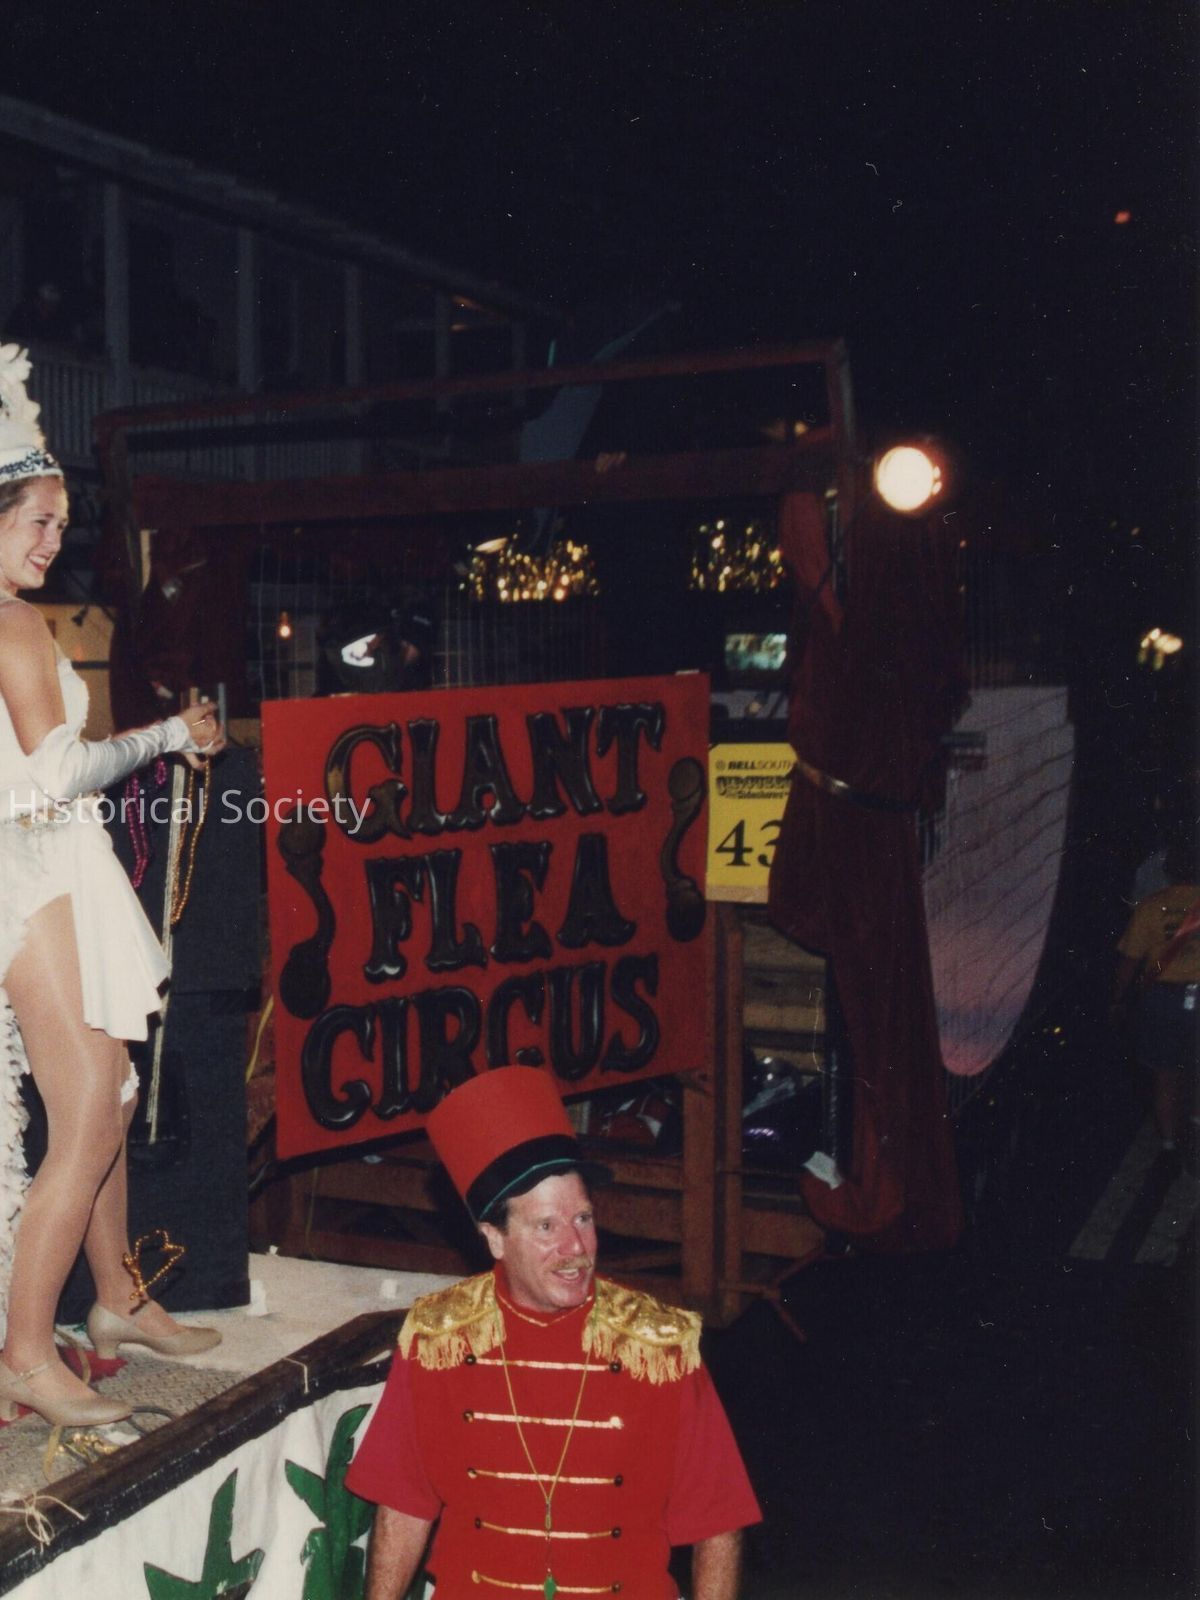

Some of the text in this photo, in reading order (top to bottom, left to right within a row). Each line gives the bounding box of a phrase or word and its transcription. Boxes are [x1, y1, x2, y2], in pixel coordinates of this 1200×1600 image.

[324, 703, 665, 843] GIANT
[364, 833, 637, 984] FLEA
[302, 952, 660, 1131] CIRCUS
